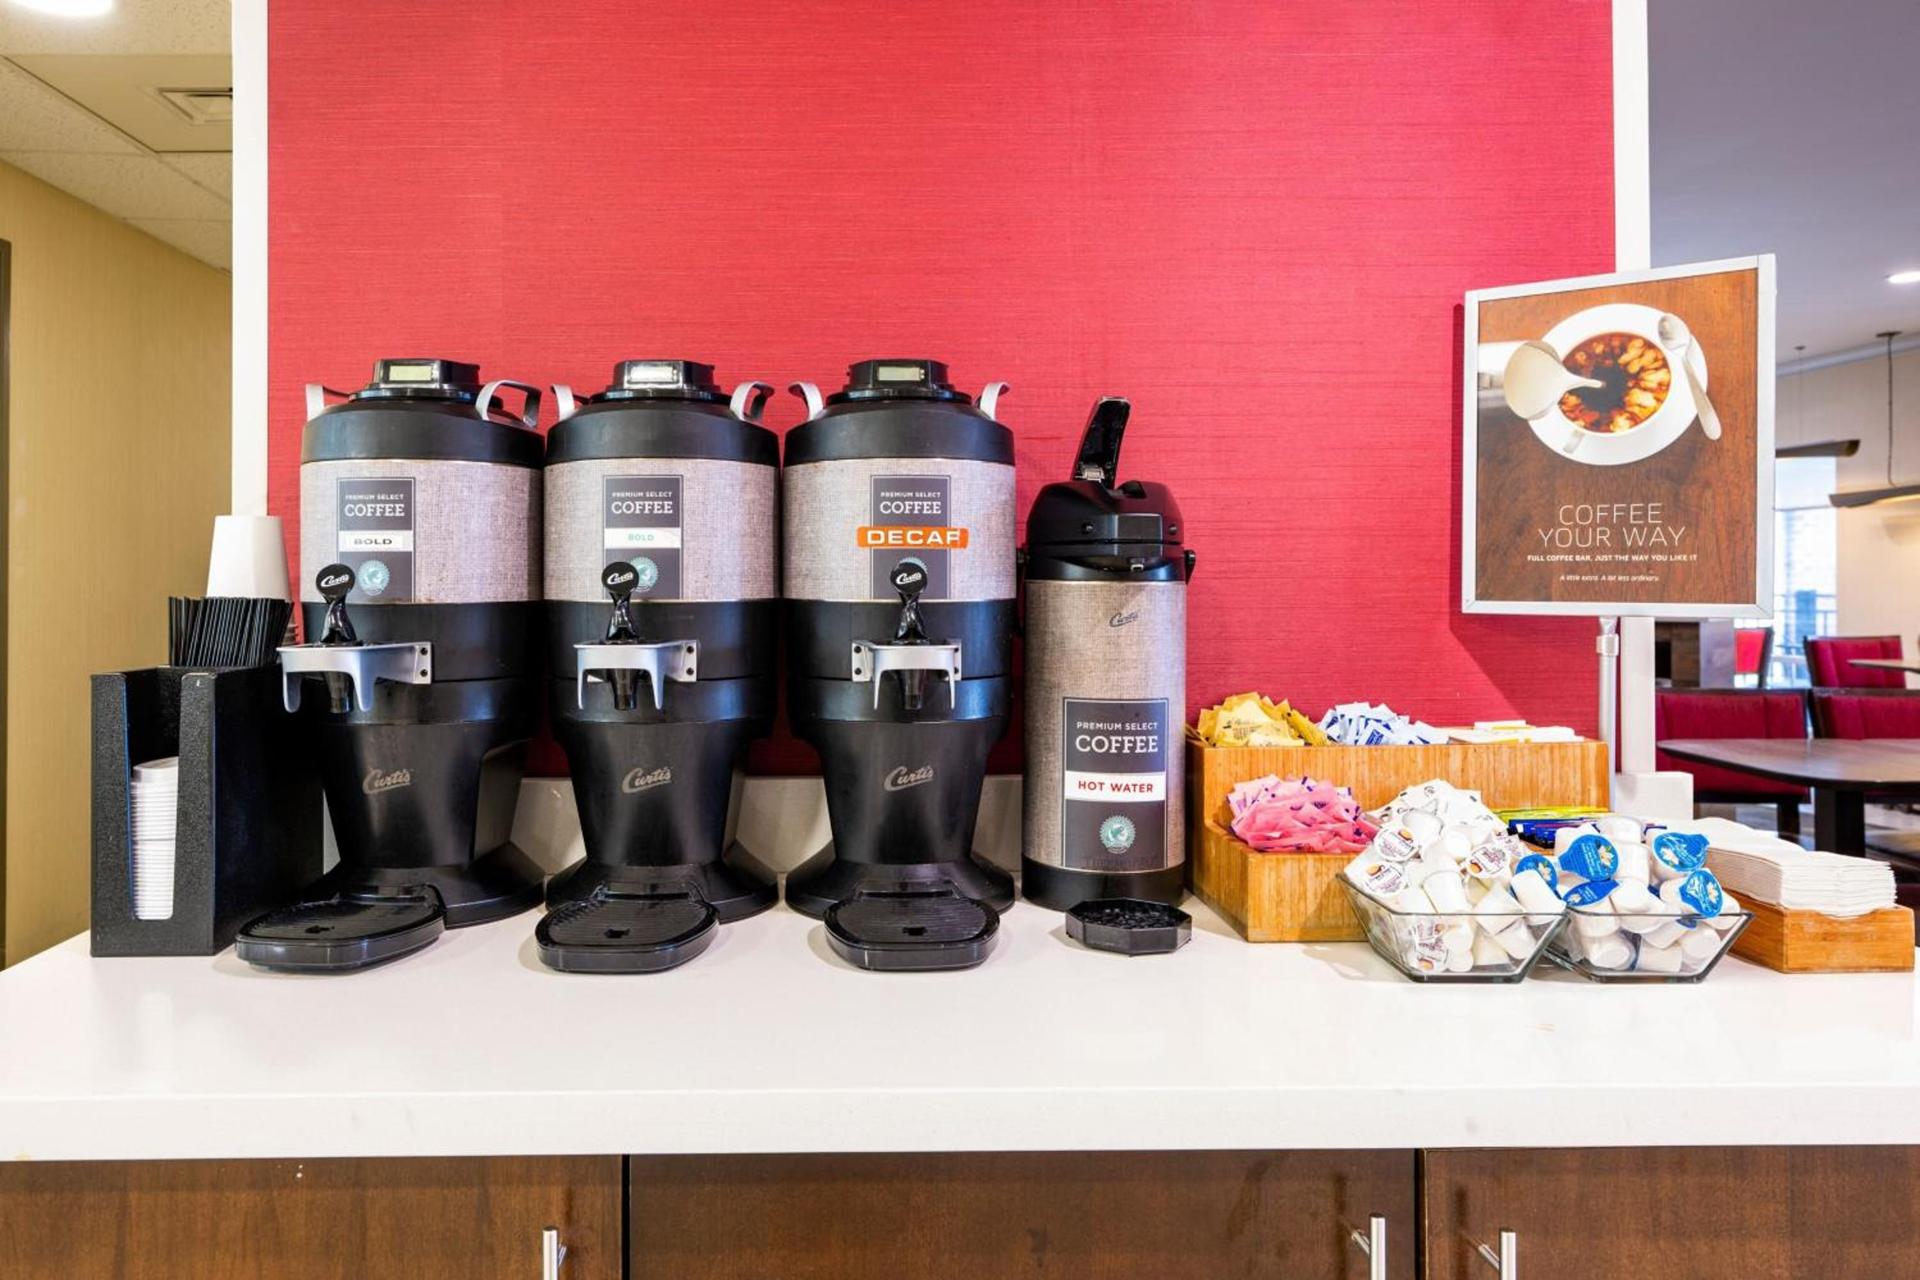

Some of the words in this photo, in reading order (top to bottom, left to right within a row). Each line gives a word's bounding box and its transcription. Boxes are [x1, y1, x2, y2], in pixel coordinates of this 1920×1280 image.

[344, 503, 405, 517] COFFEE
[611, 501, 673, 514] COFFEE
[880, 501, 942, 514] COFFEE
[1559, 503, 1663, 526] COFFEE
[628, 533, 655, 541] BOLD
[866, 529, 961, 545] DECAF
[1538, 527, 1612, 548] YOUR
[1623, 526, 1686, 547] WAY
[1527, 554, 1544, 562] FULL
[1546, 554, 1574, 562] COFFEE
[1594, 554, 1613, 562] JUST
[1614, 554, 1629, 562] THE
[1631, 554, 1649, 562] WAY
[1651, 554, 1668, 562] YOU
[1669, 554, 1688, 562] LIKE
[1689, 554, 1698, 562] IT
[1077, 721, 1122, 731] PREMIUM
[1125, 722, 1158, 731] SELECT
[1075, 735, 1159, 753] COFFEE
[362, 768, 413, 794] Curtis
[622, 767, 672, 793] Curtis
[882, 765, 933, 791] Curtis
[1078, 780, 1105, 792] HOT
[1110, 783, 1154, 794] WATER
